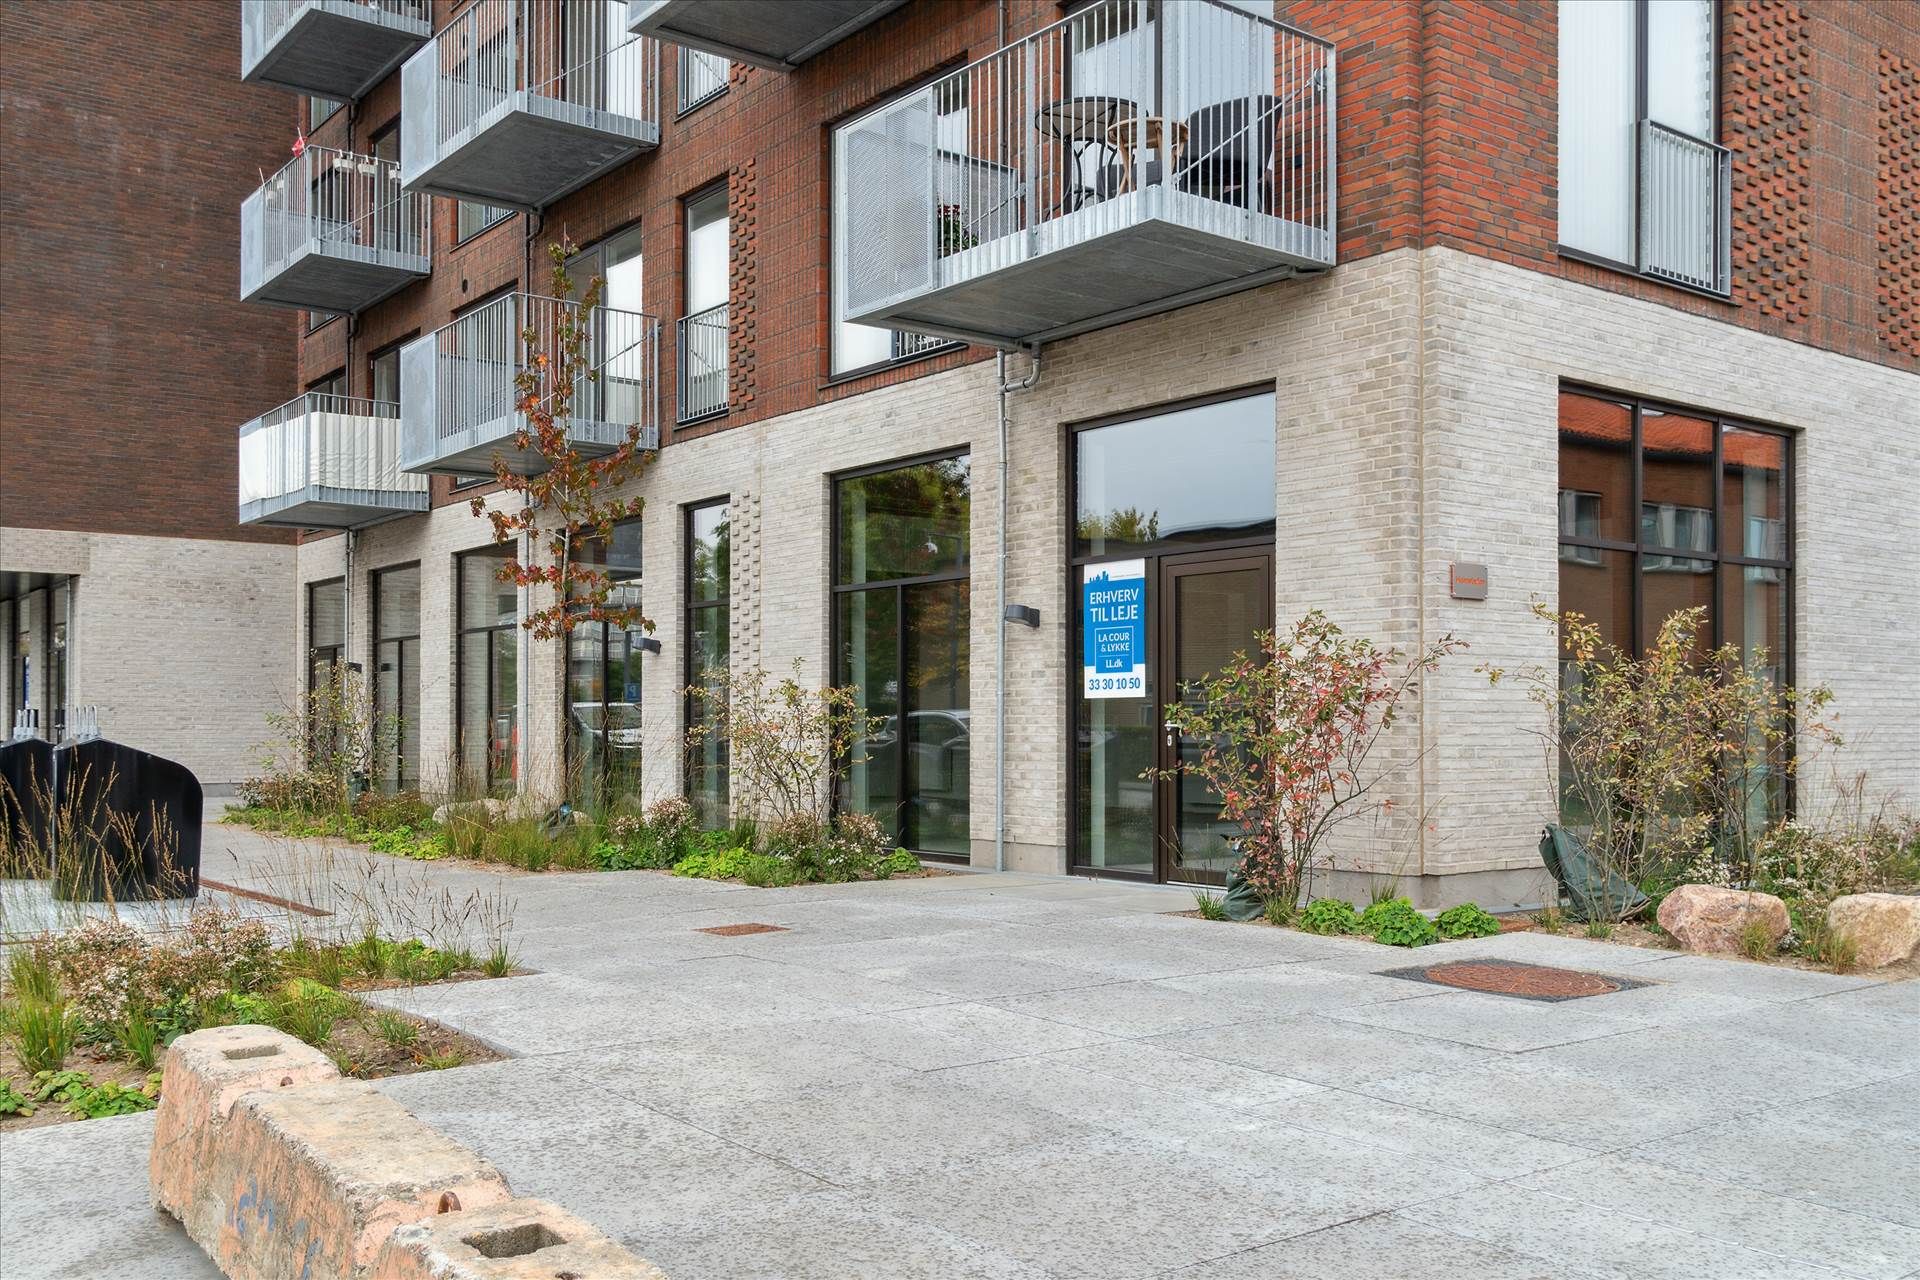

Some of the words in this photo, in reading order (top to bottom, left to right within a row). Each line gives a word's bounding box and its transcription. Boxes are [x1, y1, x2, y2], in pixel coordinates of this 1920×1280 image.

[1090, 588, 1139, 605] ERHVERV
[1090, 607, 1108, 623] TIL
[1111, 604, 1138, 621] LEJE
[1098, 634, 1108, 642] LA
[1109, 632, 1130, 641] COUR
[1101, 644, 1106, 652] &
[1107, 642, 1130, 652] LYKKE
[1089, 679, 1100, 690] 33
[1102, 679, 1114, 690] 30
[1116, 678, 1127, 689] 10
[1129, 677, 1141, 689] 50
